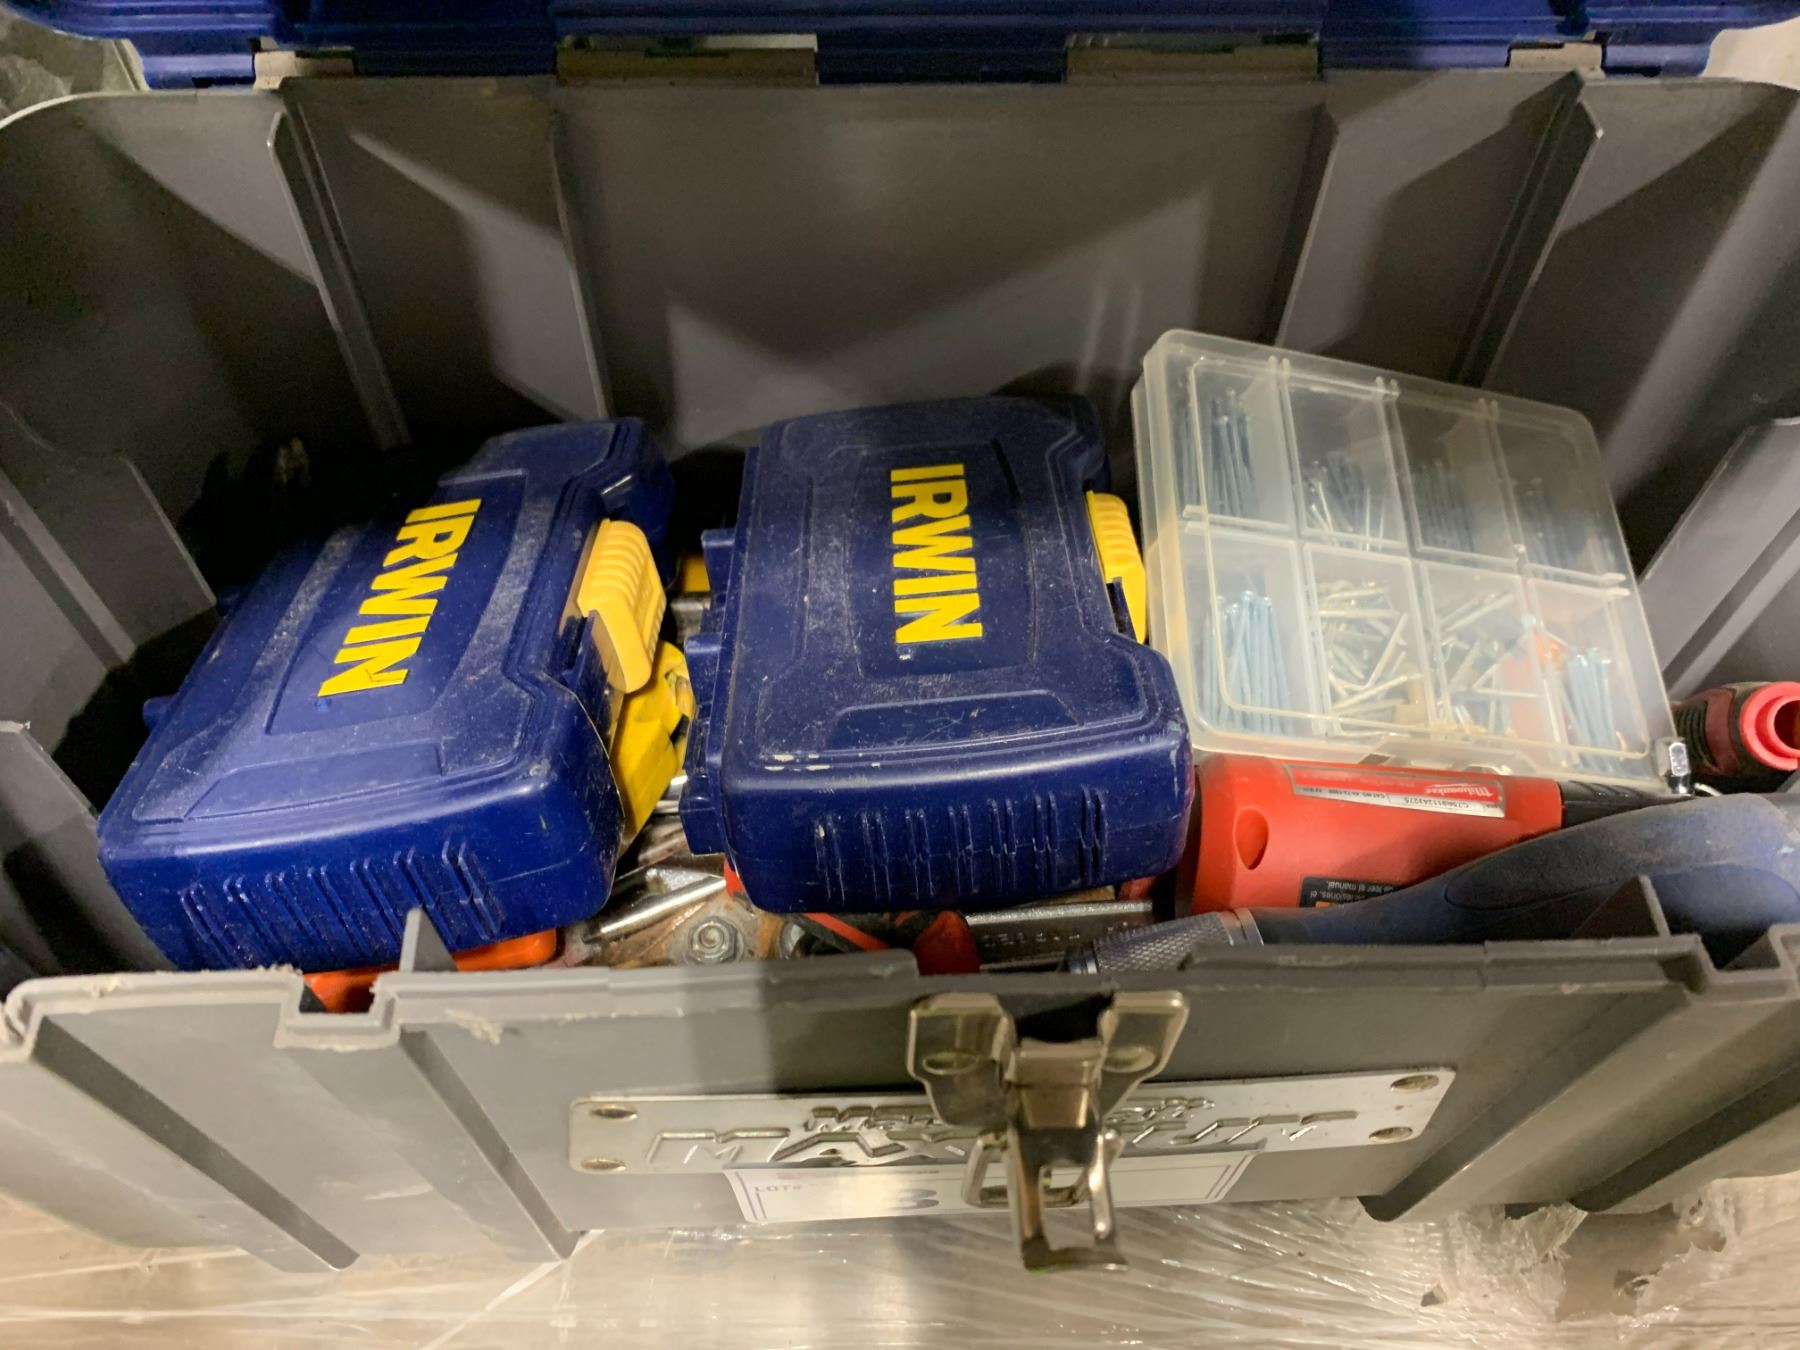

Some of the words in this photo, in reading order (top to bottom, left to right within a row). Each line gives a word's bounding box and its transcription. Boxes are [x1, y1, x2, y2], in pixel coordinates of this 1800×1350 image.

[317, 498, 482, 697] IRWIN
[891, 463, 983, 644] IRWIN
[1424, 783, 1494, 798] Milwaukee
